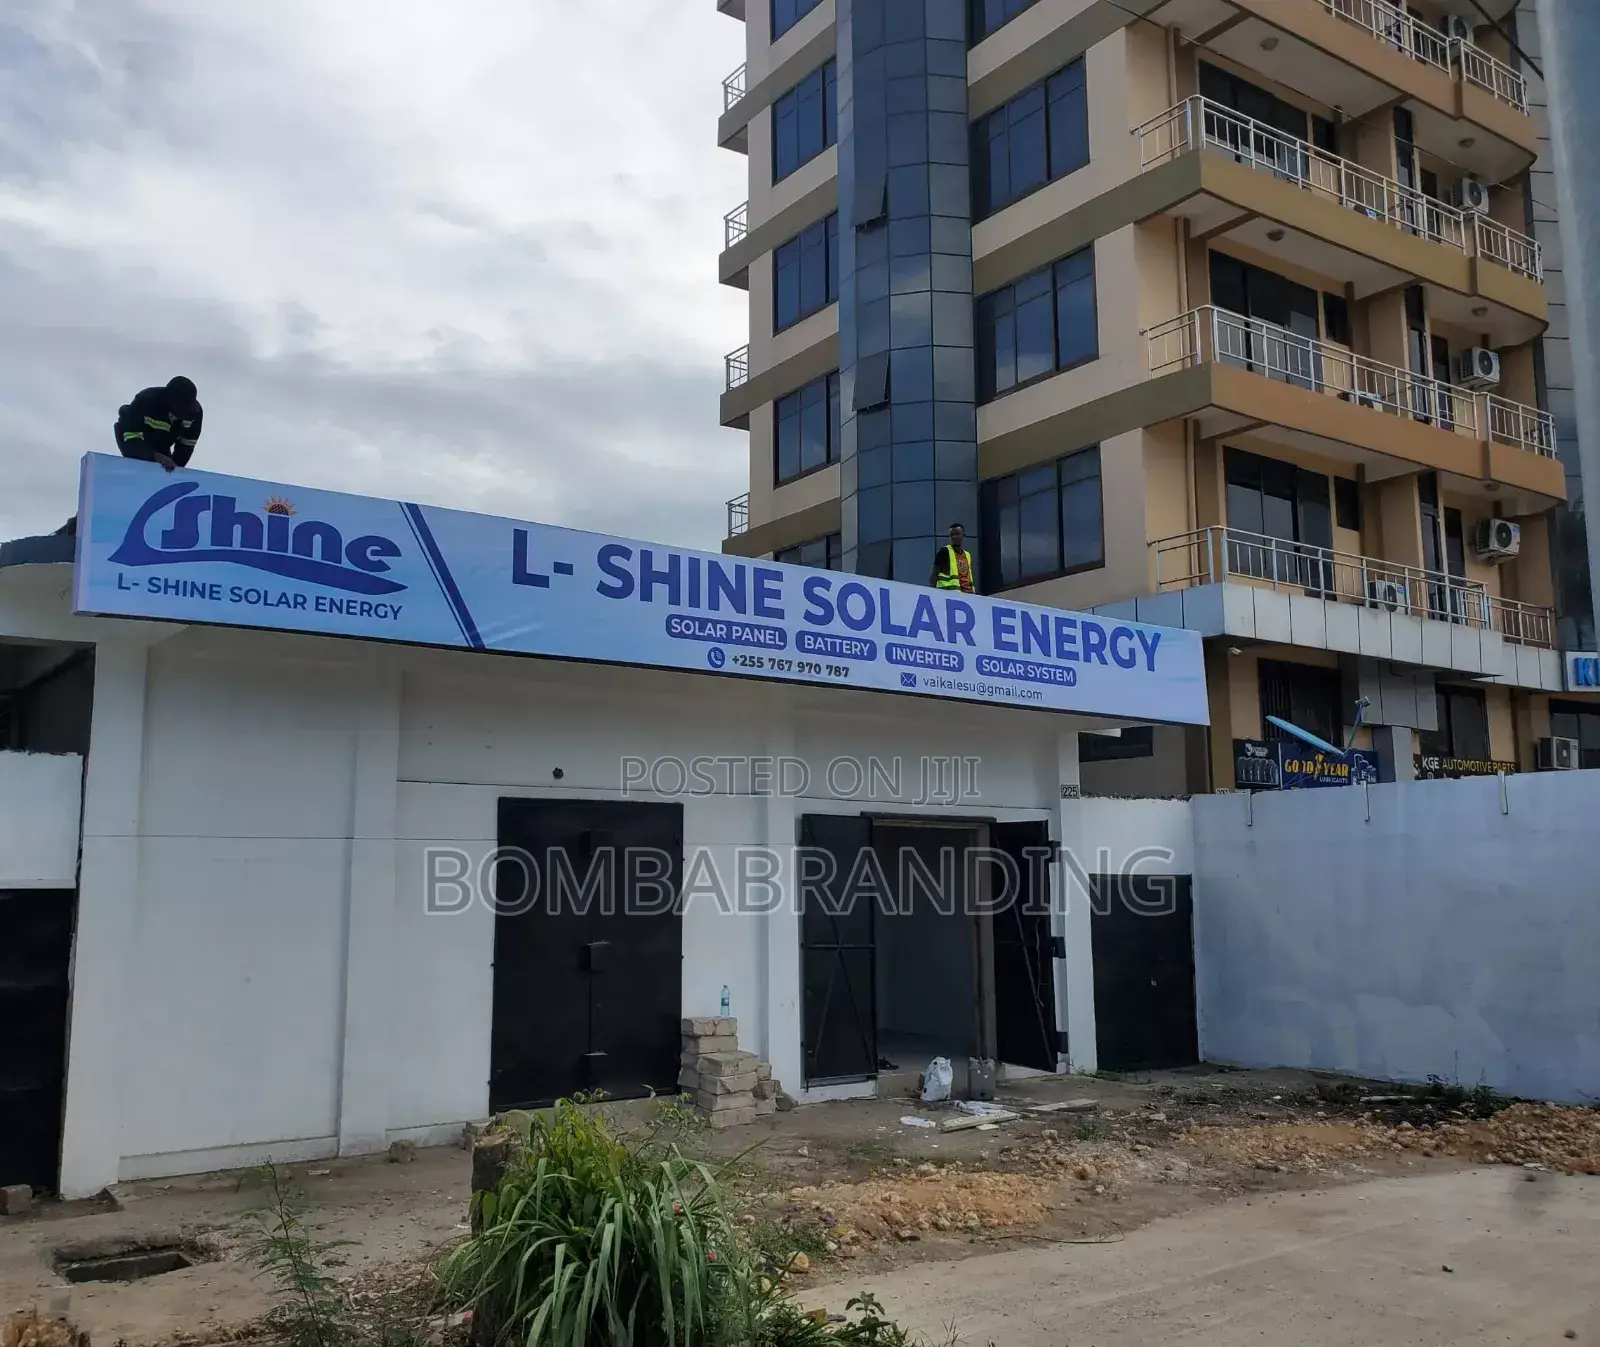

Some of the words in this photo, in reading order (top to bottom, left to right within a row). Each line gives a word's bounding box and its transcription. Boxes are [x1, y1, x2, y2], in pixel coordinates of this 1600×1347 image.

[147, 576, 222, 601] SHINE
[229, 586, 308, 611] SOLAR
[314, 596, 403, 621] ENERGY
[596, 543, 786, 620] SHINE
[802, 576, 977, 647] SOLAR
[991, 606, 1162, 673] ENERGY
[671, 619, 727, 639] SOLAR
[731, 626, 785, 646] PANEL
[803, 635, 871, 656] BATTERY
[892, 647, 959, 668] INVERTER
[731, 655, 764, 668] +255
[768, 658, 793, 671] 767
[797, 661, 822, 675] 970
[826, 664, 850, 678] 787
[982, 659, 1025, 677] SOLAR
[1027, 664, 1074, 683] SYSTEM
[1573, 656, 1600, 686] K
[922, 676, 1043, 700] vaikalesu@gmail.com
[1422, 757, 1440, 771] KGE
[1442, 759, 1492, 772] AUTOMOTIVE
[1492, 762, 1515, 773] PARTS
[1062, 786, 1078, 797] 225
